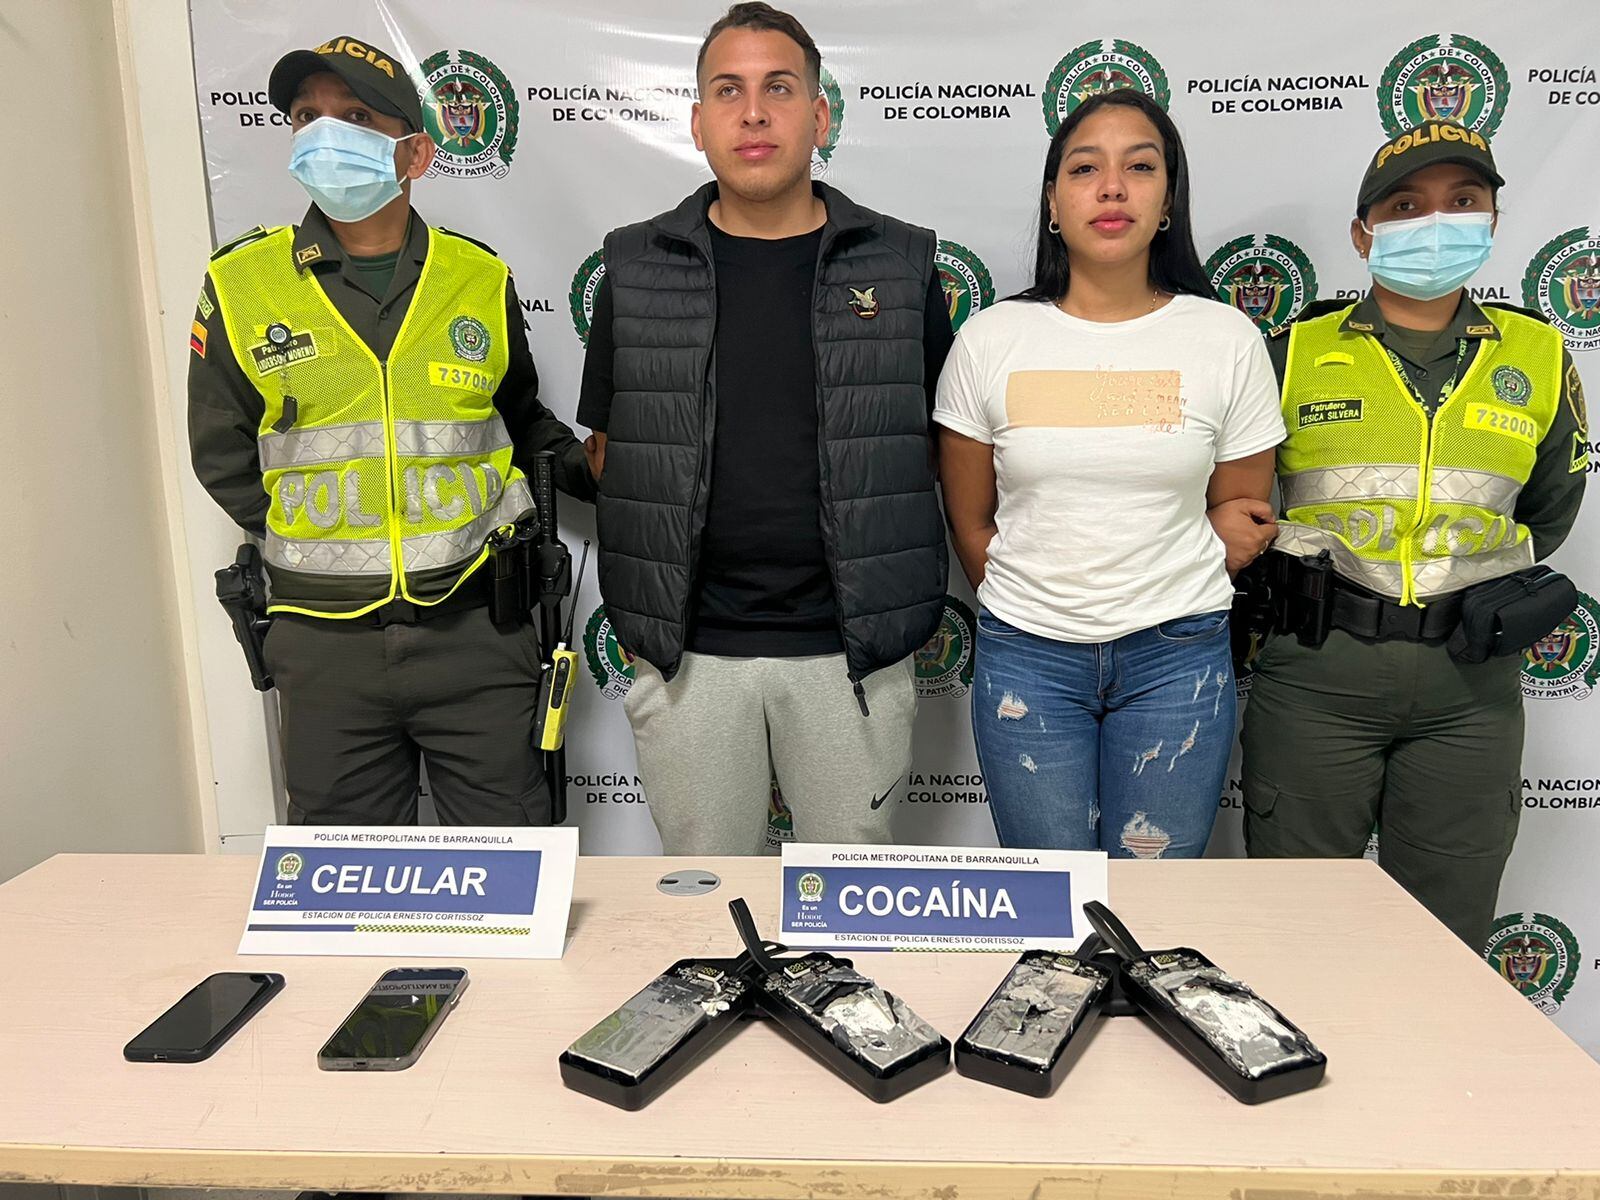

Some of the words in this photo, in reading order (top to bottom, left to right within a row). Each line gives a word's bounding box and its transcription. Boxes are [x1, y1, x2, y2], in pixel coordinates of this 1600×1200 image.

[314, 39, 394, 78] LICIA
[1058, 60, 1092, 112] REPUBLICA
[1101, 54, 1116, 62] DE
[1394, 54, 1429, 106] REPUBLICA
[1439, 48, 1454, 56] DE
[1463, 54, 1494, 104] COLOMBIA
[1528, 65, 1597, 83] POLICÍA
[527, 85, 601, 101] POLICÍA
[860, 82, 932, 99] POLICÍA
[938, 84, 1036, 98] NACIONAL
[1187, 75, 1262, 93] POLICÍA
[1268, 75, 1369, 91] NACIONAL
[211, 92, 268, 106] POLIC
[450, 65, 463, 73] DE
[473, 71, 505, 122] COLOMBIA
[1549, 91, 1571, 105] DE
[884, 107, 908, 120] DE
[913, 106, 1011, 120] COLOMBIA
[1212, 101, 1236, 114] DE
[1241, 97, 1343, 113] COLOMBIA
[240, 113, 265, 126] DE
[553, 108, 576, 122] DE
[435, 148, 454, 162] ICIA
[465, 133, 504, 164] NACIONAL
[1377, 124, 1487, 169] POLICIA
[465, 161, 497, 176] PATRIA
[1212, 253, 1244, 285] UBLICA
[1253, 248, 1267, 256] DE
[1276, 254, 1302, 303] COLOMBIA
[1540, 246, 1577, 297] REPUBLICA
[585, 266, 606, 312] REPUBLIC
[951, 259, 979, 308] COLOMBIA
[1301, 413, 1324, 424] YESICA
[1327, 409, 1359, 420] SILVERA
[1476, 409, 1534, 438] 722003
[598, 621, 610, 652] REPUB
[944, 608, 970, 650] COLOMBIA
[1577, 608, 1597, 650] OLOMBIA
[926, 660, 965, 685] NACIONAL
[1547, 660, 1592, 686] NACIONAL
[926, 683, 956, 695] PATRIA
[1521, 686, 1537, 696] IOS
[1546, 684, 1579, 697] PATRIA
[930, 774, 983, 786] NACIO
[1538, 779, 1600, 791] NACIO
[586, 793, 607, 803] DE
[1524, 797, 1600, 808] OLOMBIA
[314, 833, 349, 841] POLICIA
[351, 834, 426, 843] METROPOLITANA
[428, 835, 441, 843] DE
[443, 835, 513, 844] BARRANQUILLA
[832, 853, 868, 861] POLICIA
[870, 854, 949, 863] METROPOLITANA
[950, 855, 963, 863] DE
[965, 855, 1040, 865] BARRANQUILLA
[311, 864, 488, 896] CELULAR
[838, 880, 1018, 919] COCAÍNA
[302, 911, 343, 919] ESTACION
[345, 911, 357, 919] DE
[358, 912, 391, 920] POLICIA
[393, 912, 433, 920] ERNESTO
[435, 913, 485, 921] CORTISSOZ
[834, 934, 878, 942] ESTACION
[894, 935, 929, 943] POLICIA
[931, 936, 972, 944] ERNESTO
[974, 937, 1025, 945] CORTISSOZ
[1543, 929, 1566, 969] COLOMBIA
